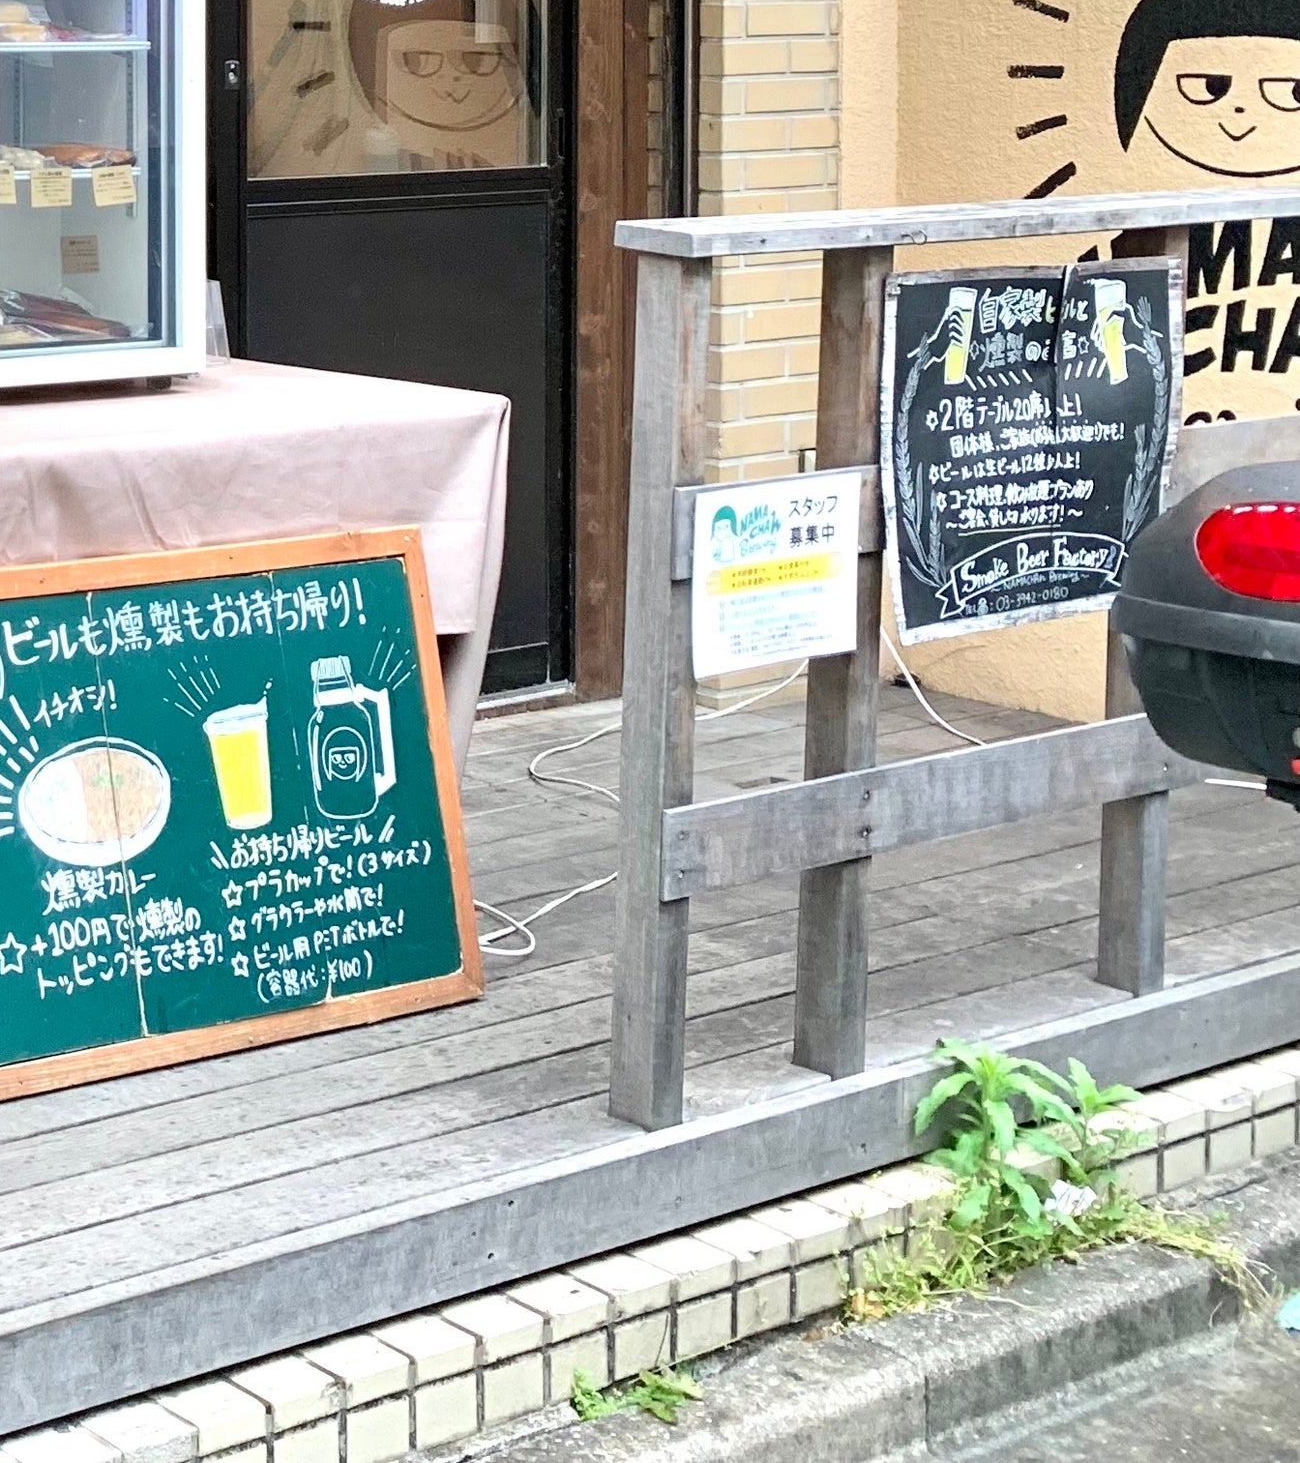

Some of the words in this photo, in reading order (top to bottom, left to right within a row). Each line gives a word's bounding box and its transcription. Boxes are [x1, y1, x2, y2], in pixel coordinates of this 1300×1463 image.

[788, 494, 839, 518] スタッフ
[788, 521, 836, 549] 募集中
[961, 557, 1009, 594] Smoke
[1016, 542, 1049, 574] Beer
[1052, 536, 1109, 570] Factory
[0, 576, 368, 667] ビールも燻製もお持ち帰り!
[33, 678, 118, 729] イチオシ!
[41, 867, 157, 916] 燻製カレー
[39, 932, 225, 1000] トッピングもできます!
